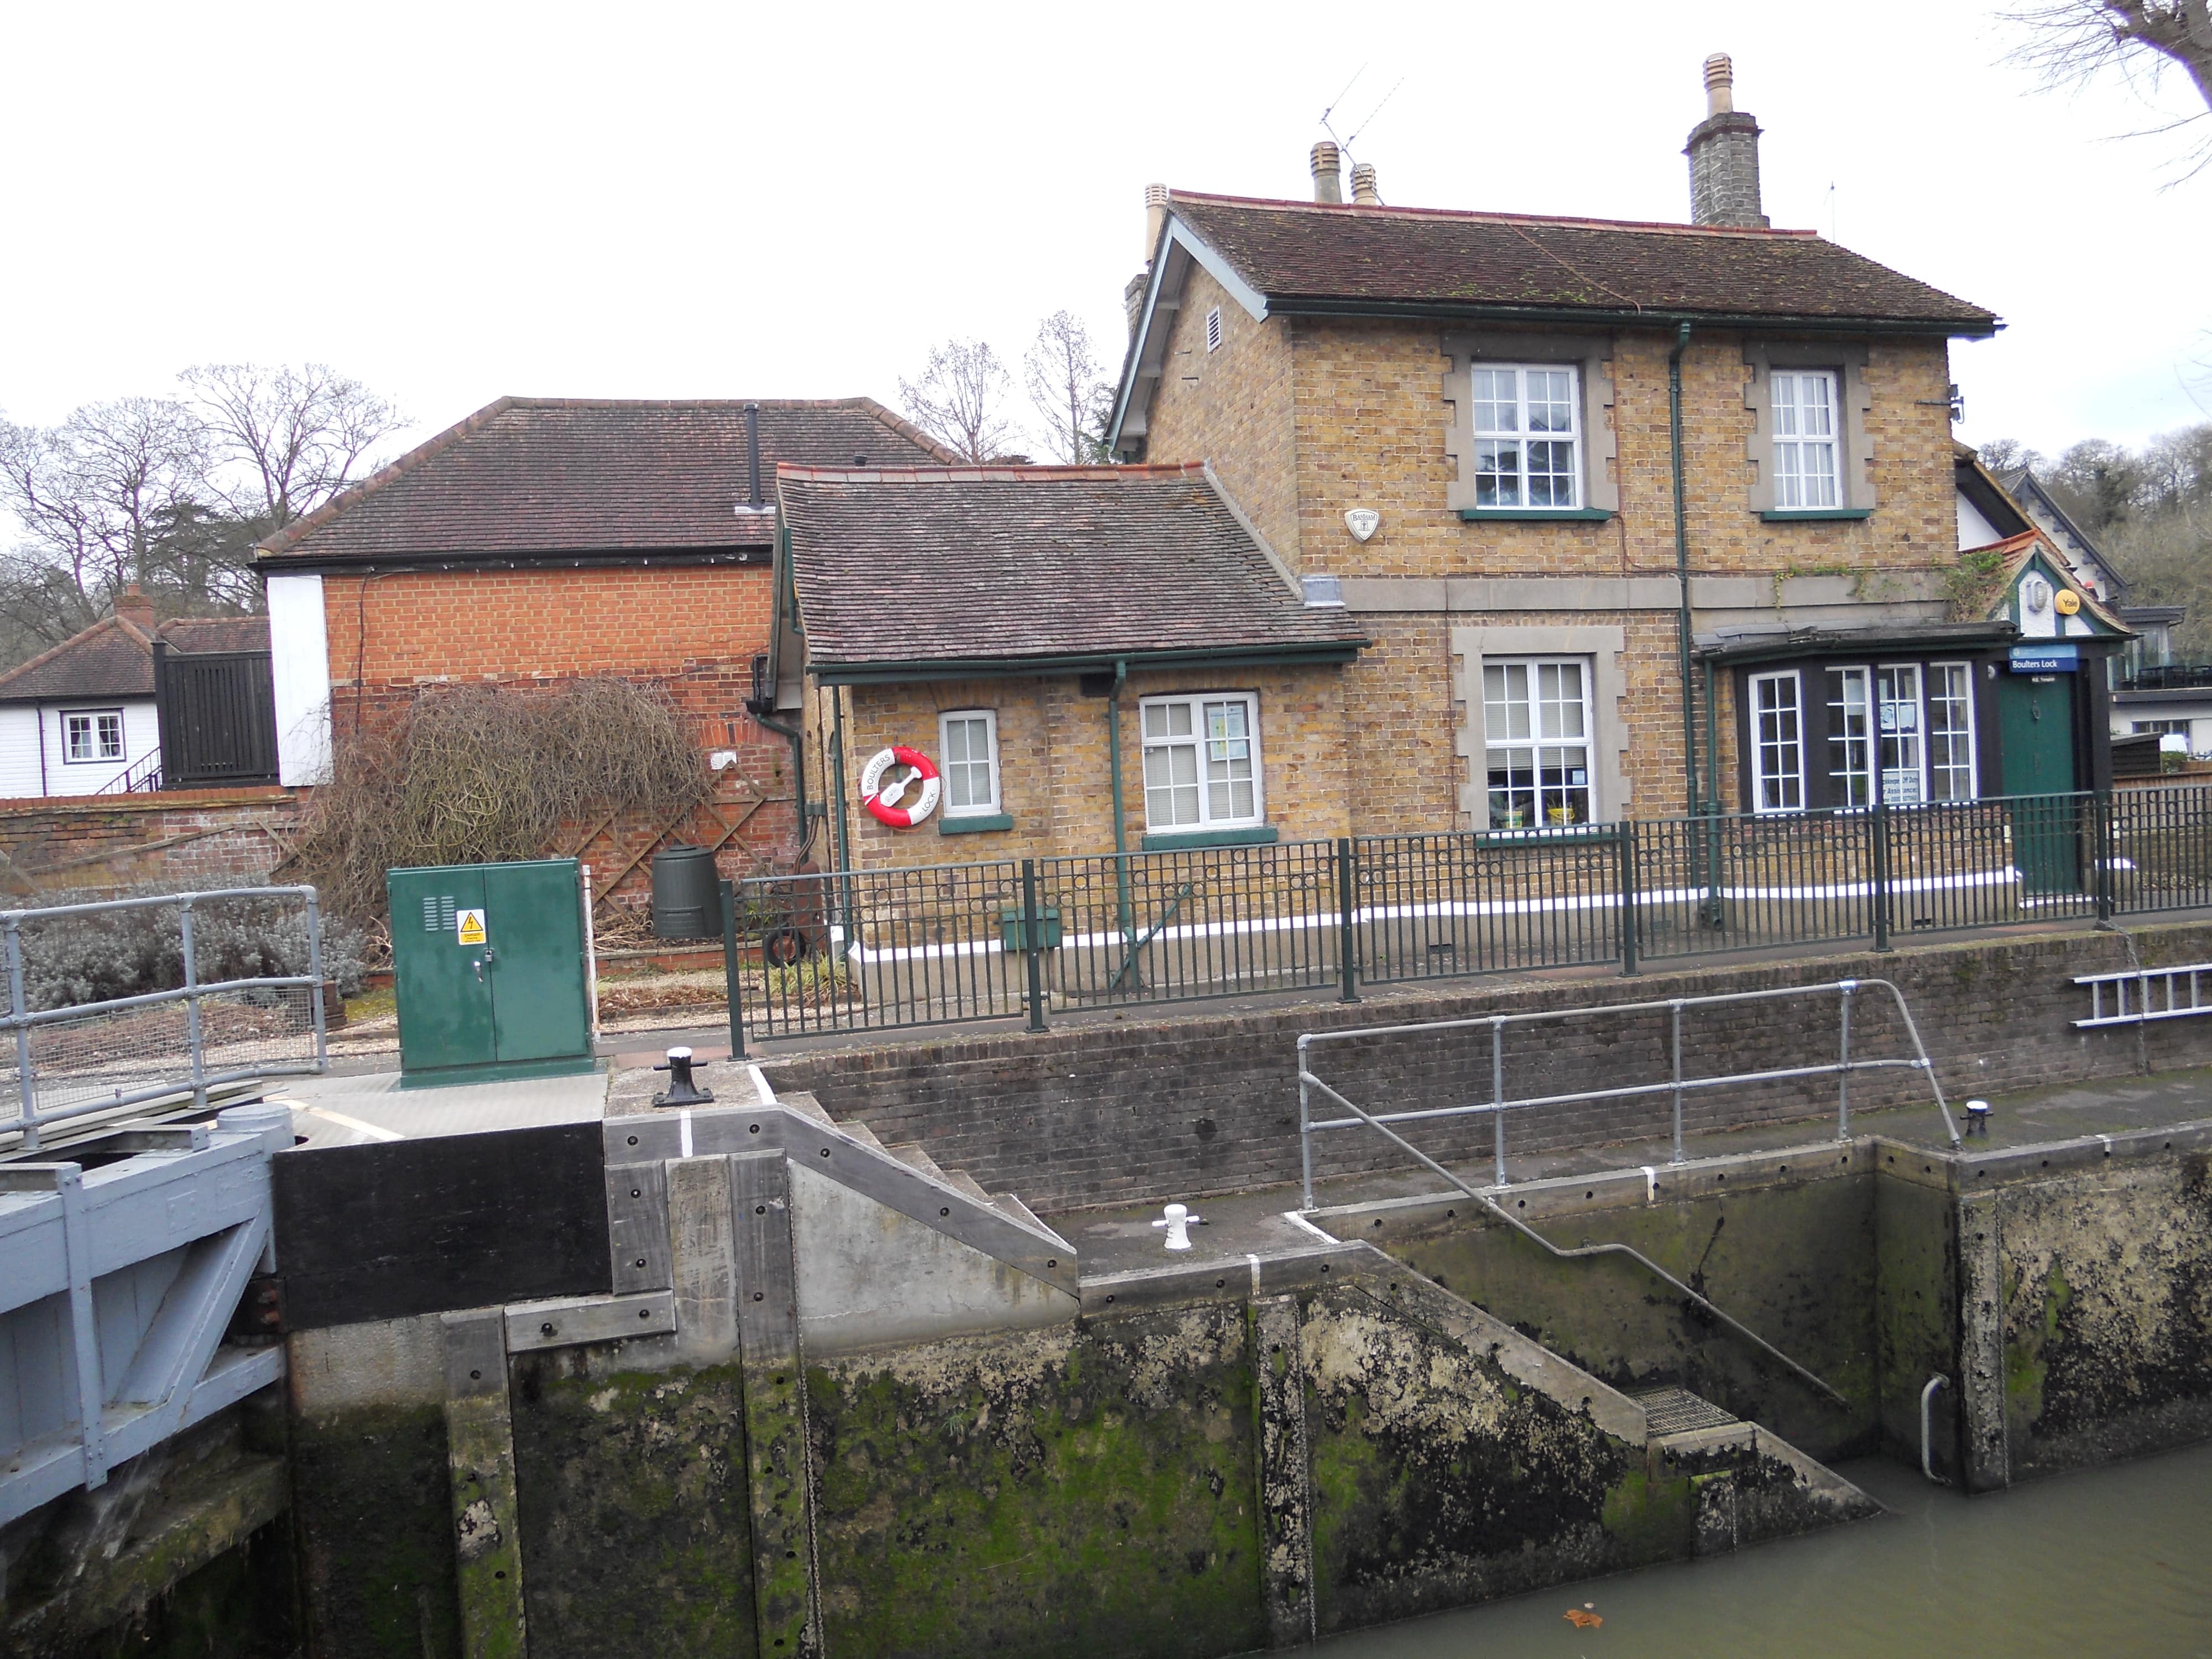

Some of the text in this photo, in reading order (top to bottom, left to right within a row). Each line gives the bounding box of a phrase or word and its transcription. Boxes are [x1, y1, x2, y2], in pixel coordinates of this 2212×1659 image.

[2063, 599, 2078, 607] Yale
[867, 754, 890, 790] BOULTERS
[922, 791, 936, 812] LOCK
